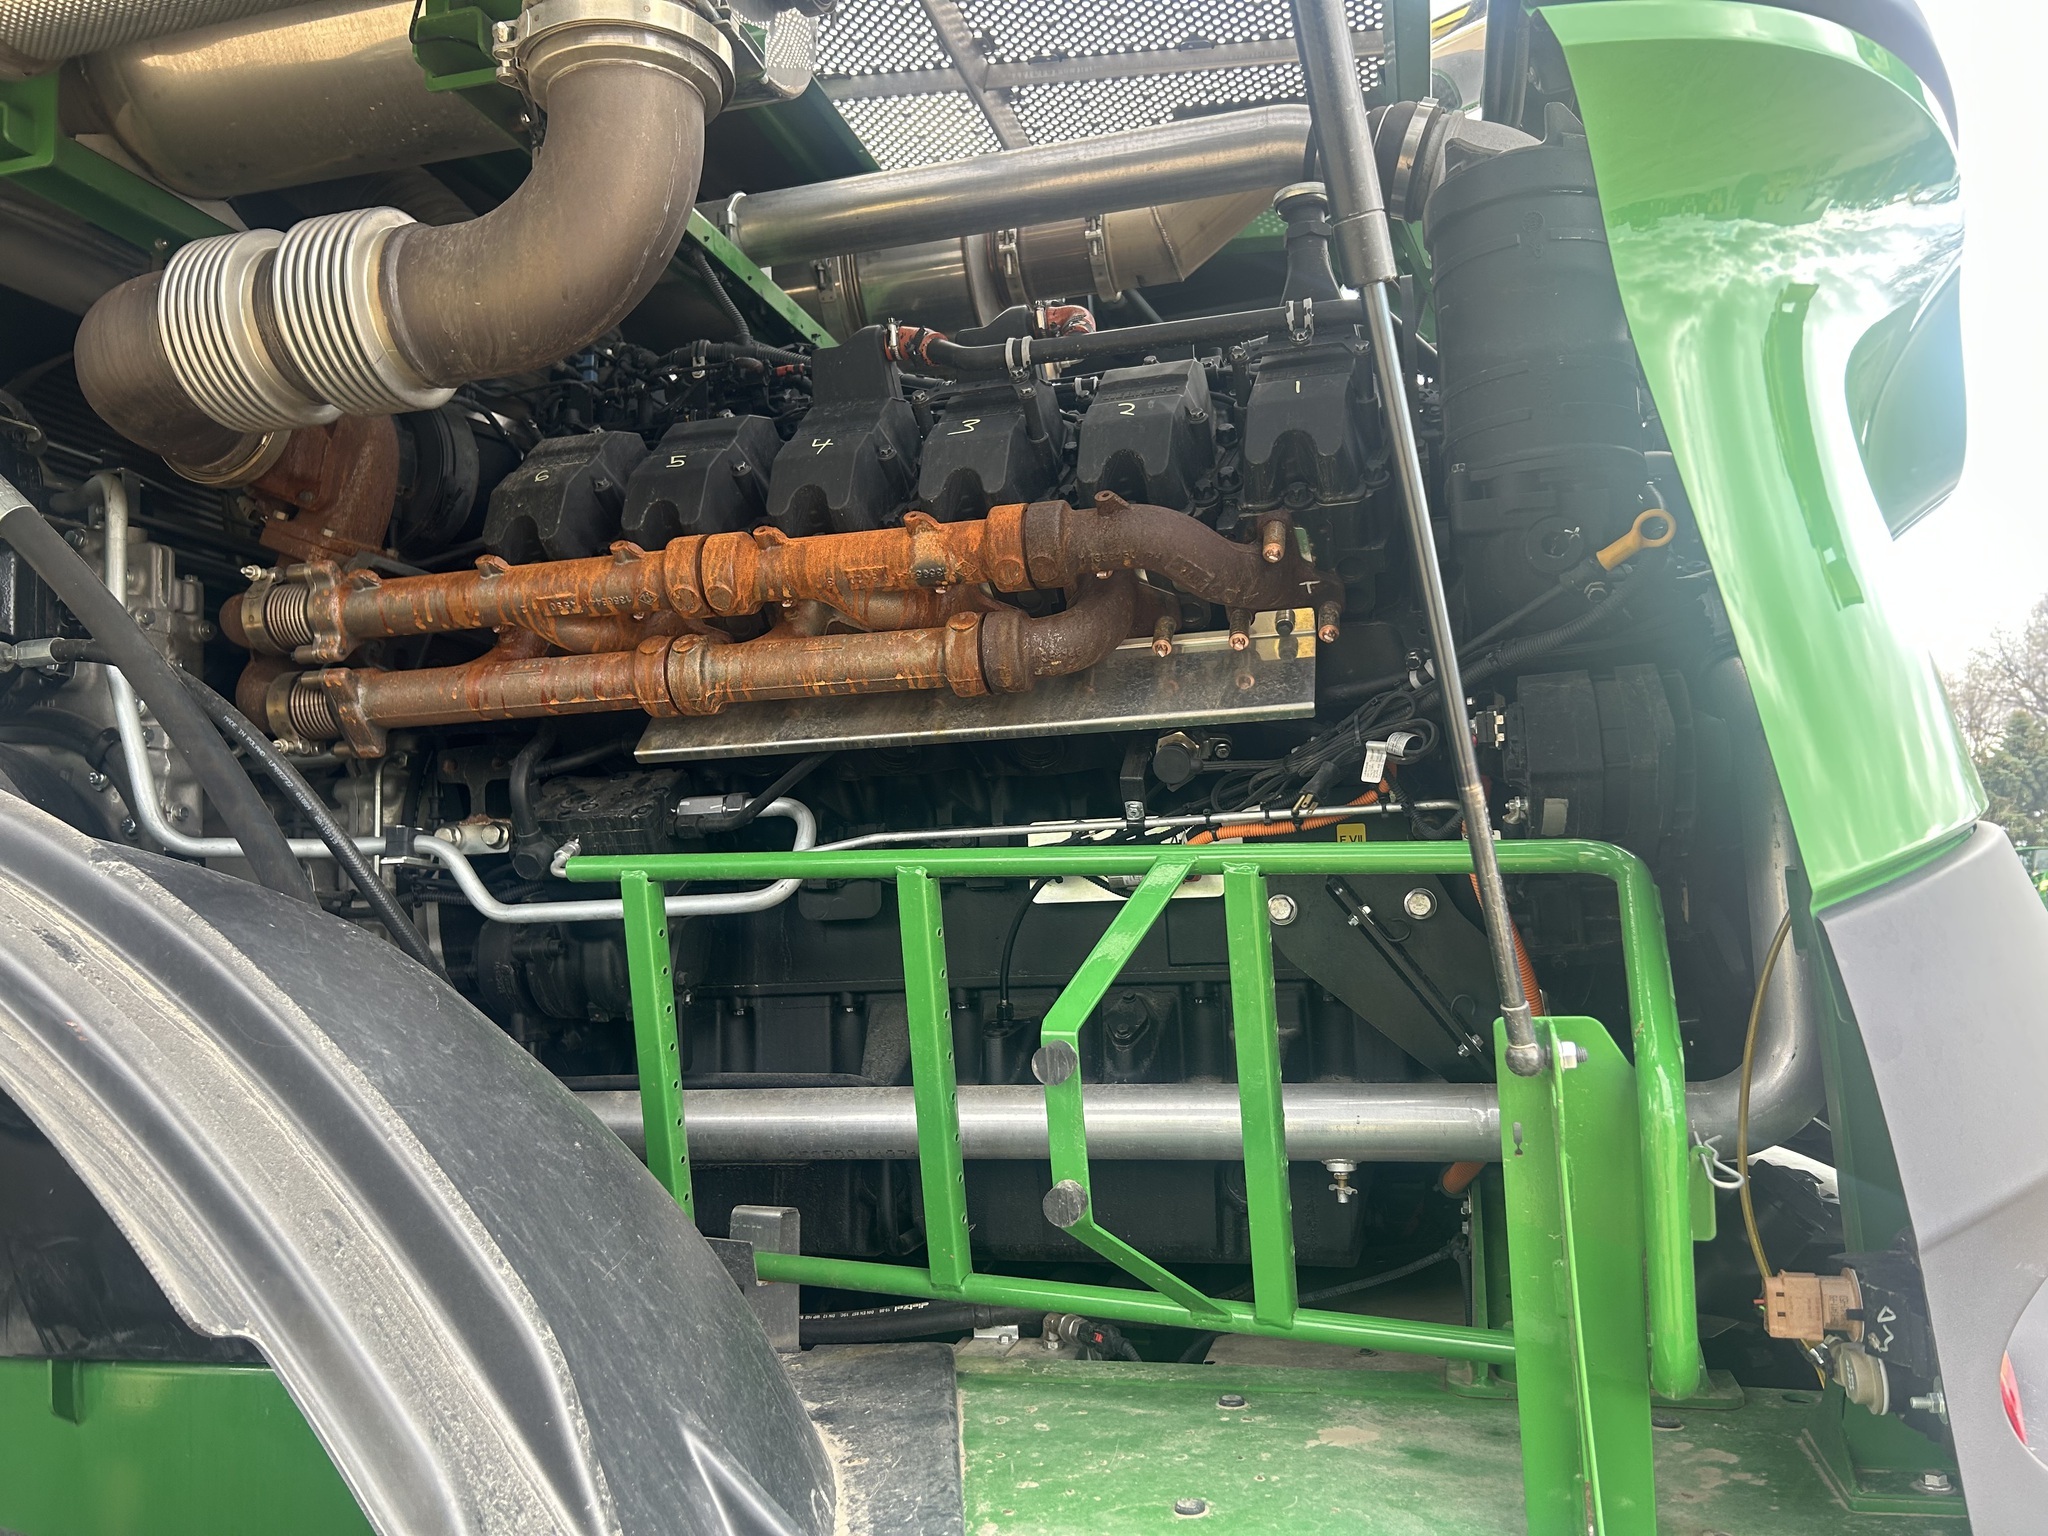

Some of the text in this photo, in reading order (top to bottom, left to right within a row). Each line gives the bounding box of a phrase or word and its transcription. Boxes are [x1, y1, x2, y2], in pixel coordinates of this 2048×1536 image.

[1294, 380, 1302, 394] 1
[1117, 402, 1136, 416] 2
[947, 418, 981, 436] 3
[811, 438, 834, 455] 4
[665, 455, 687, 468] 5
[534, 470, 550, 483] 6
[223, 715, 238, 730] MADE
[245, 736, 266, 757] POLAND
